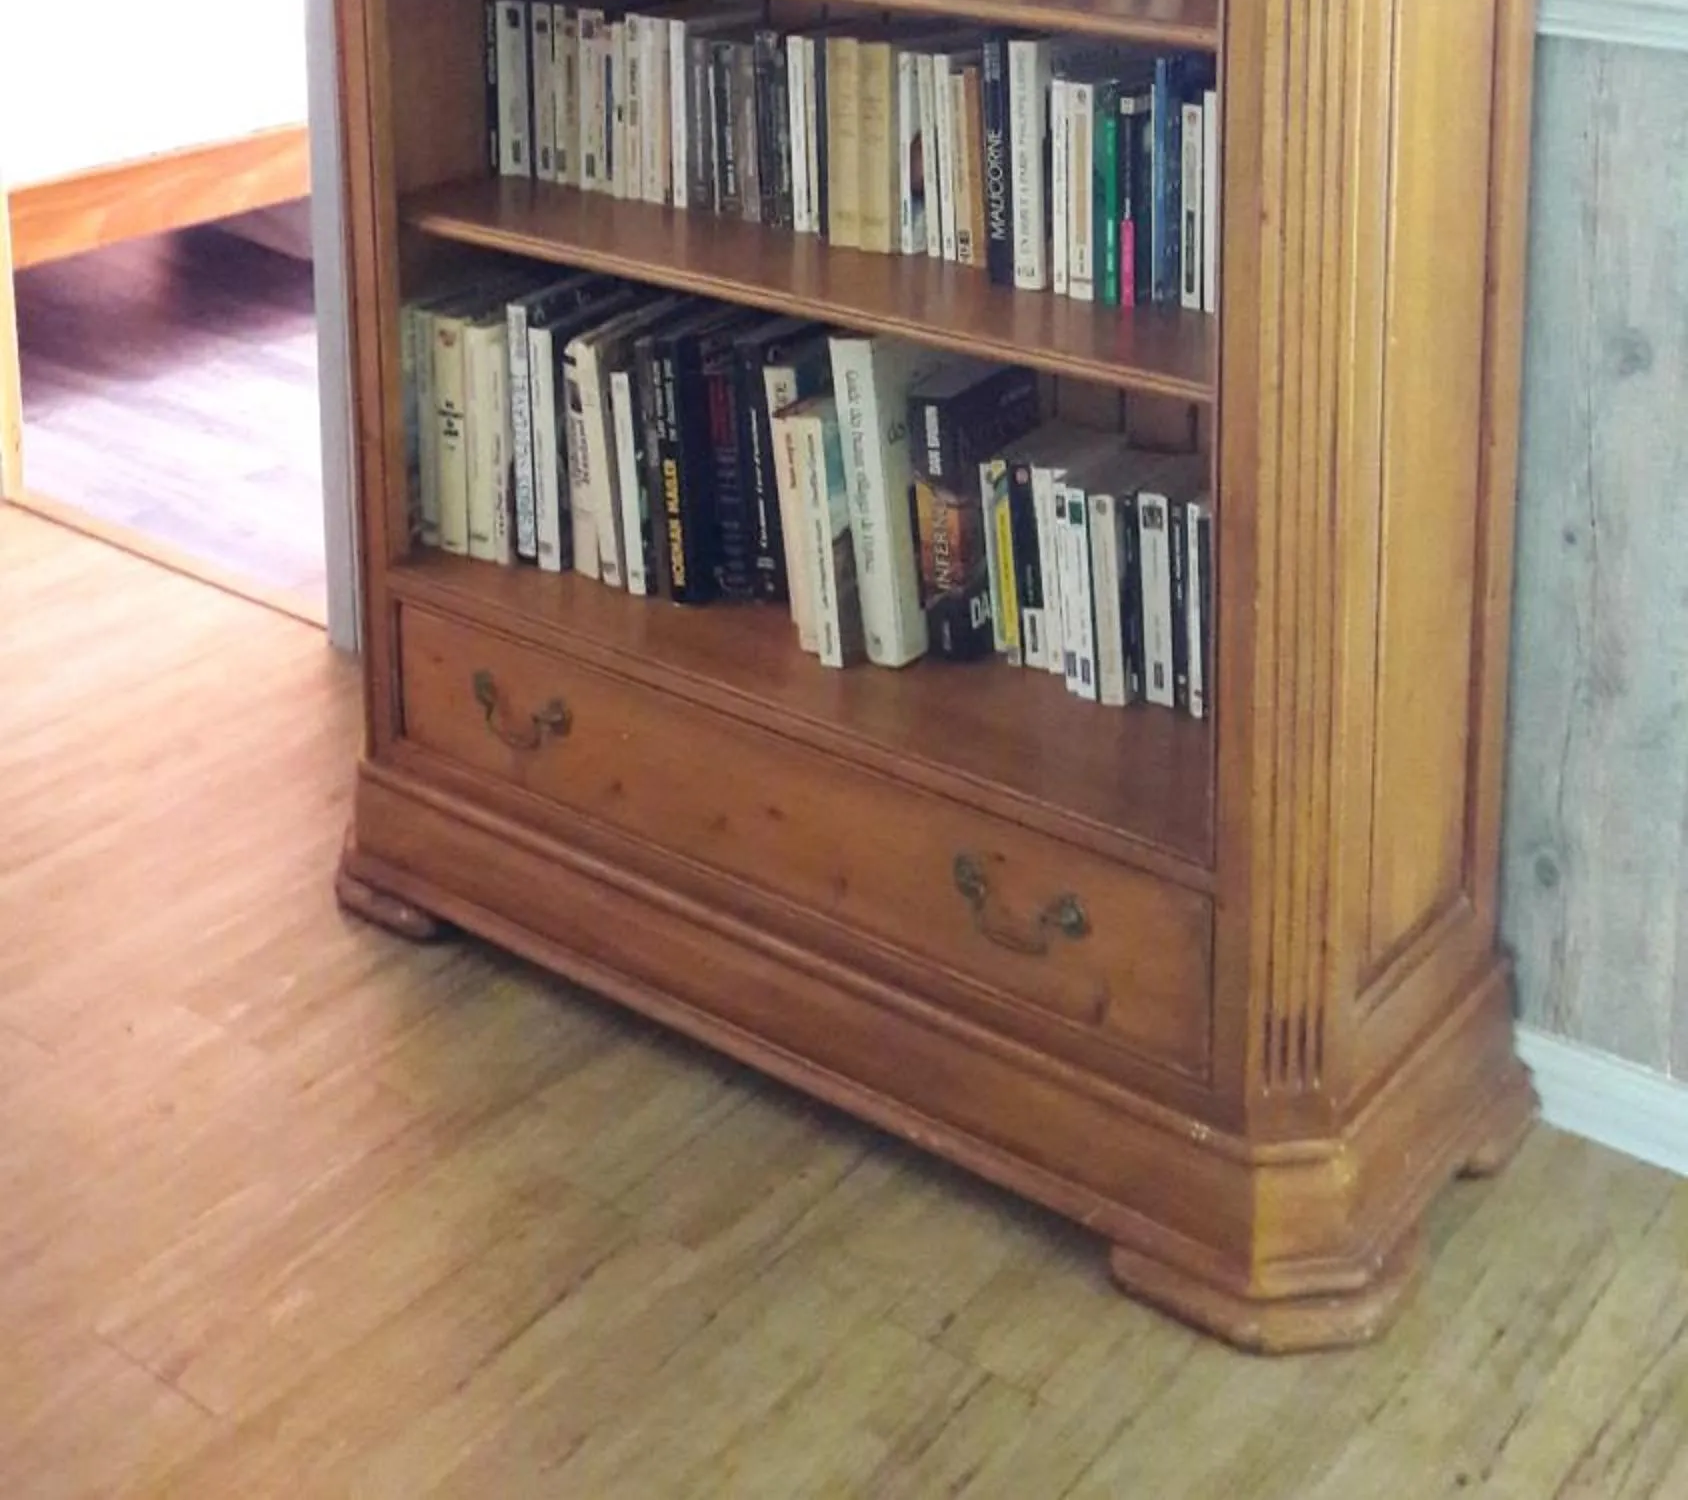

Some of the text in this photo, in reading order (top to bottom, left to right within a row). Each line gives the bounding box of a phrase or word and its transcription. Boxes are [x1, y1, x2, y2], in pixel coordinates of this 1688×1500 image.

[924, 404, 943, 477] DAN BROWN
[661, 457, 687, 588] NORMAN MAILER
[929, 488, 955, 591] INFERNO
